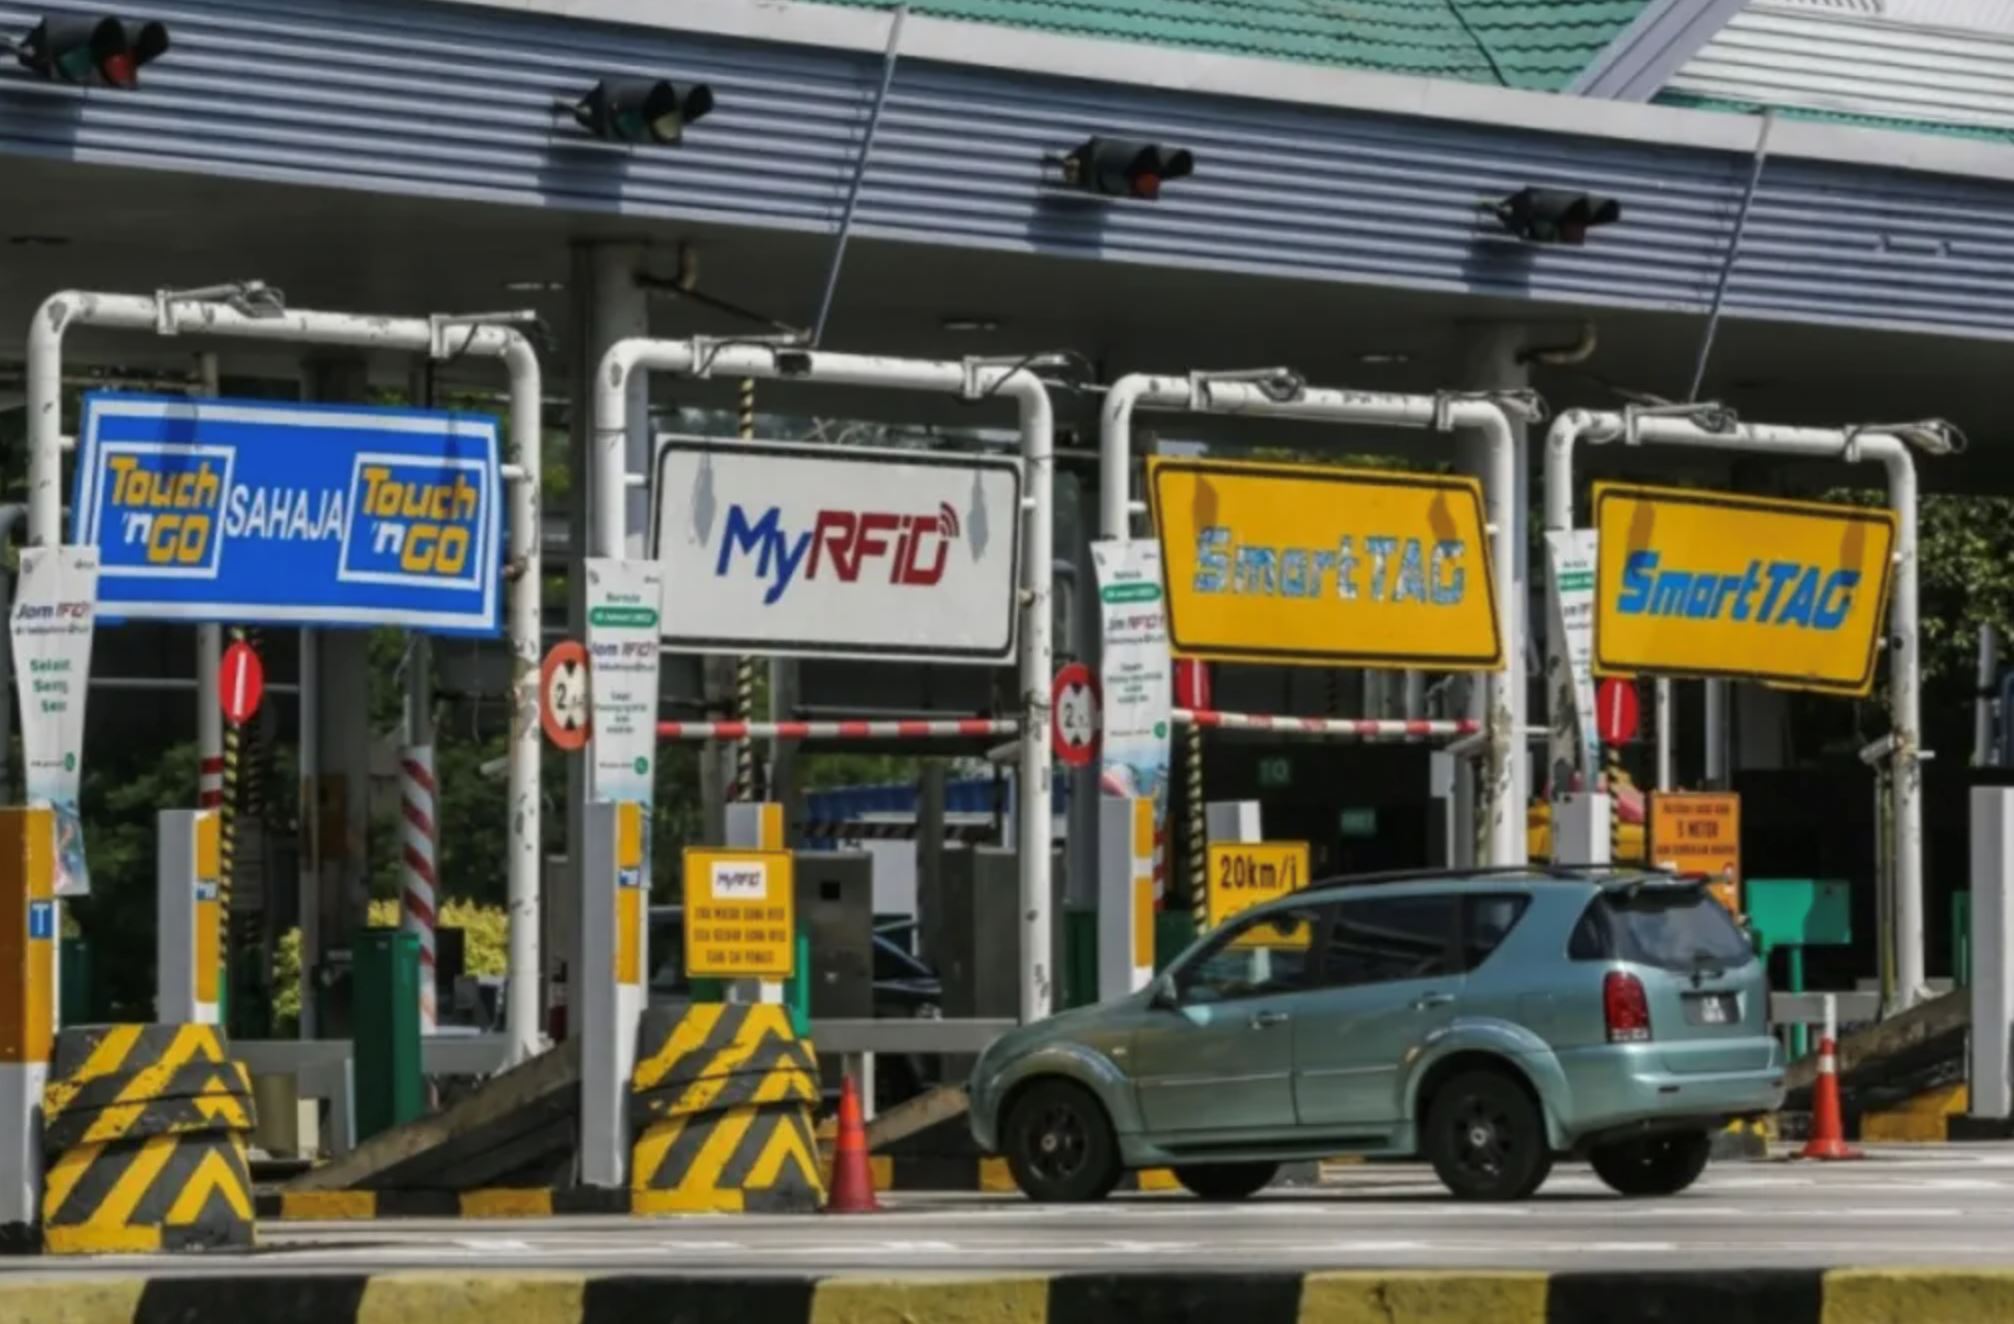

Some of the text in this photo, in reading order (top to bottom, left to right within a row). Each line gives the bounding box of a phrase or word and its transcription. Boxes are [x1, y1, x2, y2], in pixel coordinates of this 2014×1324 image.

[108, 456, 220, 509] Touch
[361, 467, 478, 521] Touch
[224, 484, 346, 543] SAHAJA
[1615, 550, 1862, 631] SmartTAG
